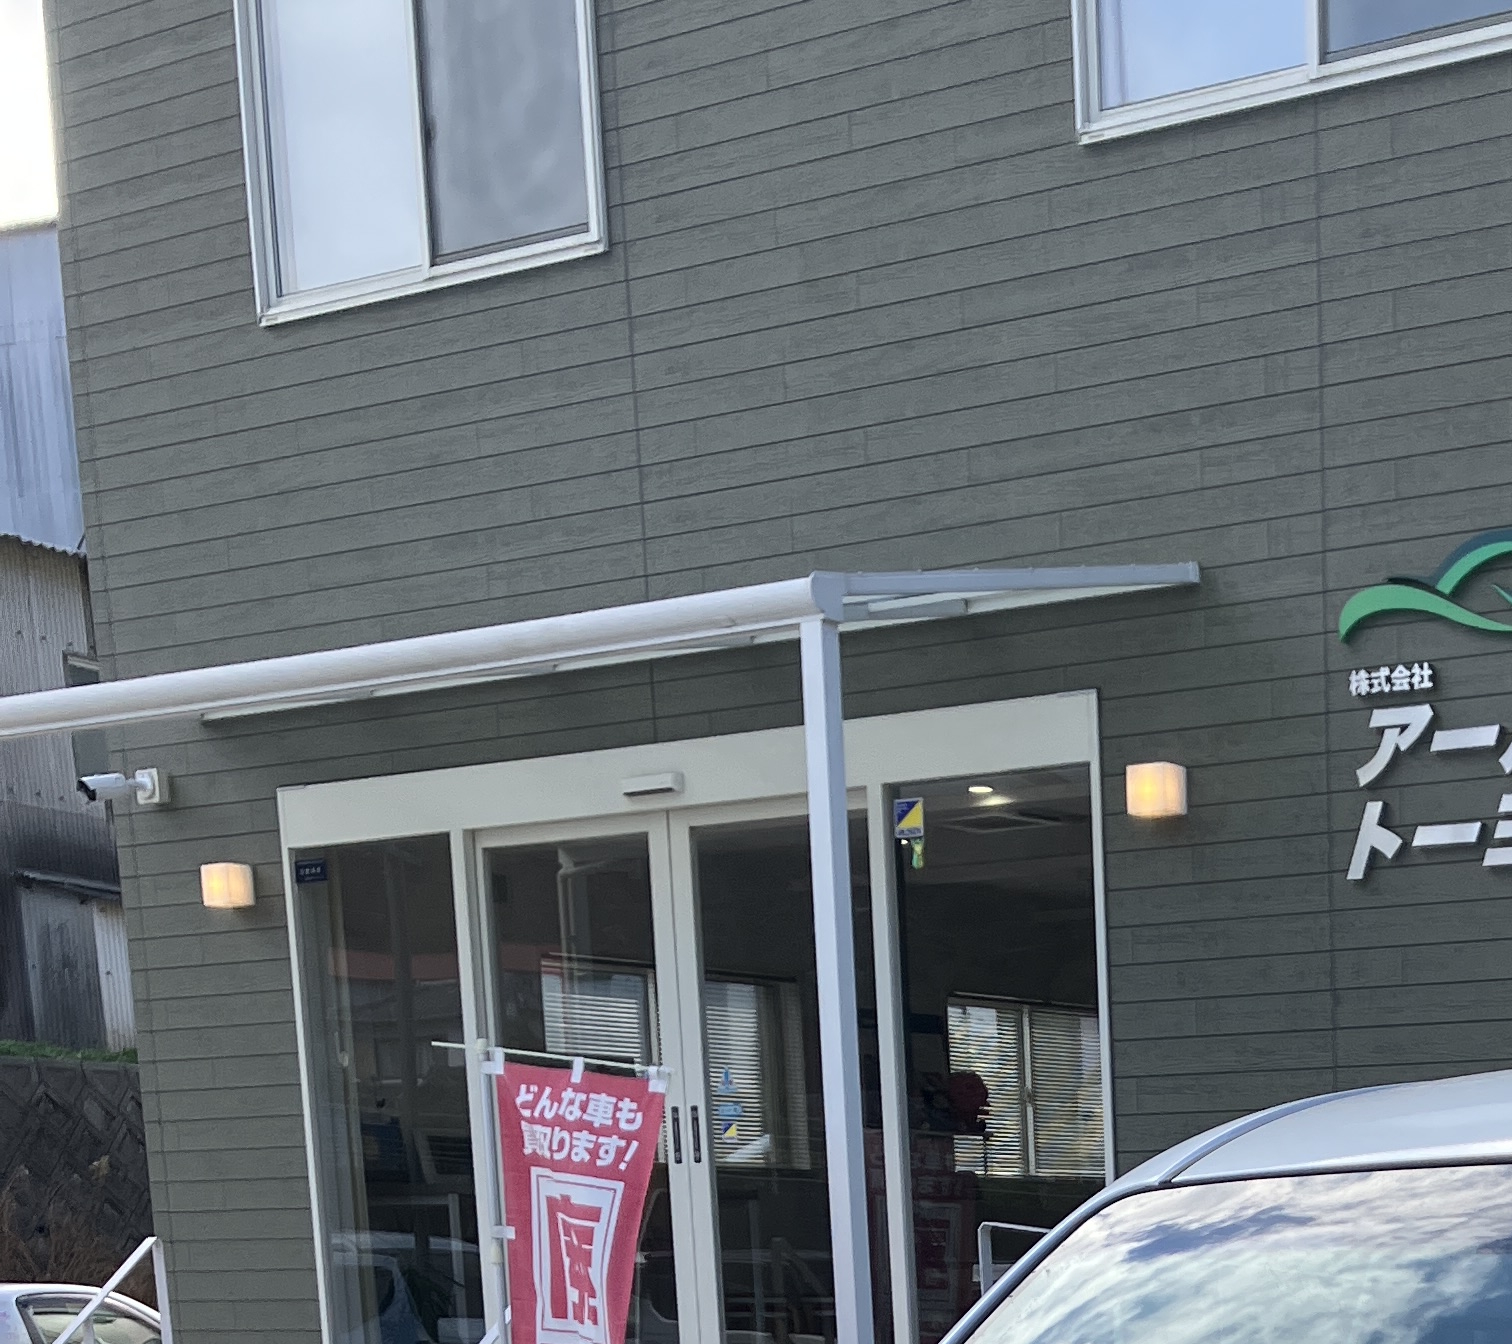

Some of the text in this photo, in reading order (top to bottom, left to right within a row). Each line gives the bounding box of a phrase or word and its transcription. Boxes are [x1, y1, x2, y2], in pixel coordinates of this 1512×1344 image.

[1348, 661, 1434, 697] 株式会社
[515, 1083, 644, 1131] どんな車も
